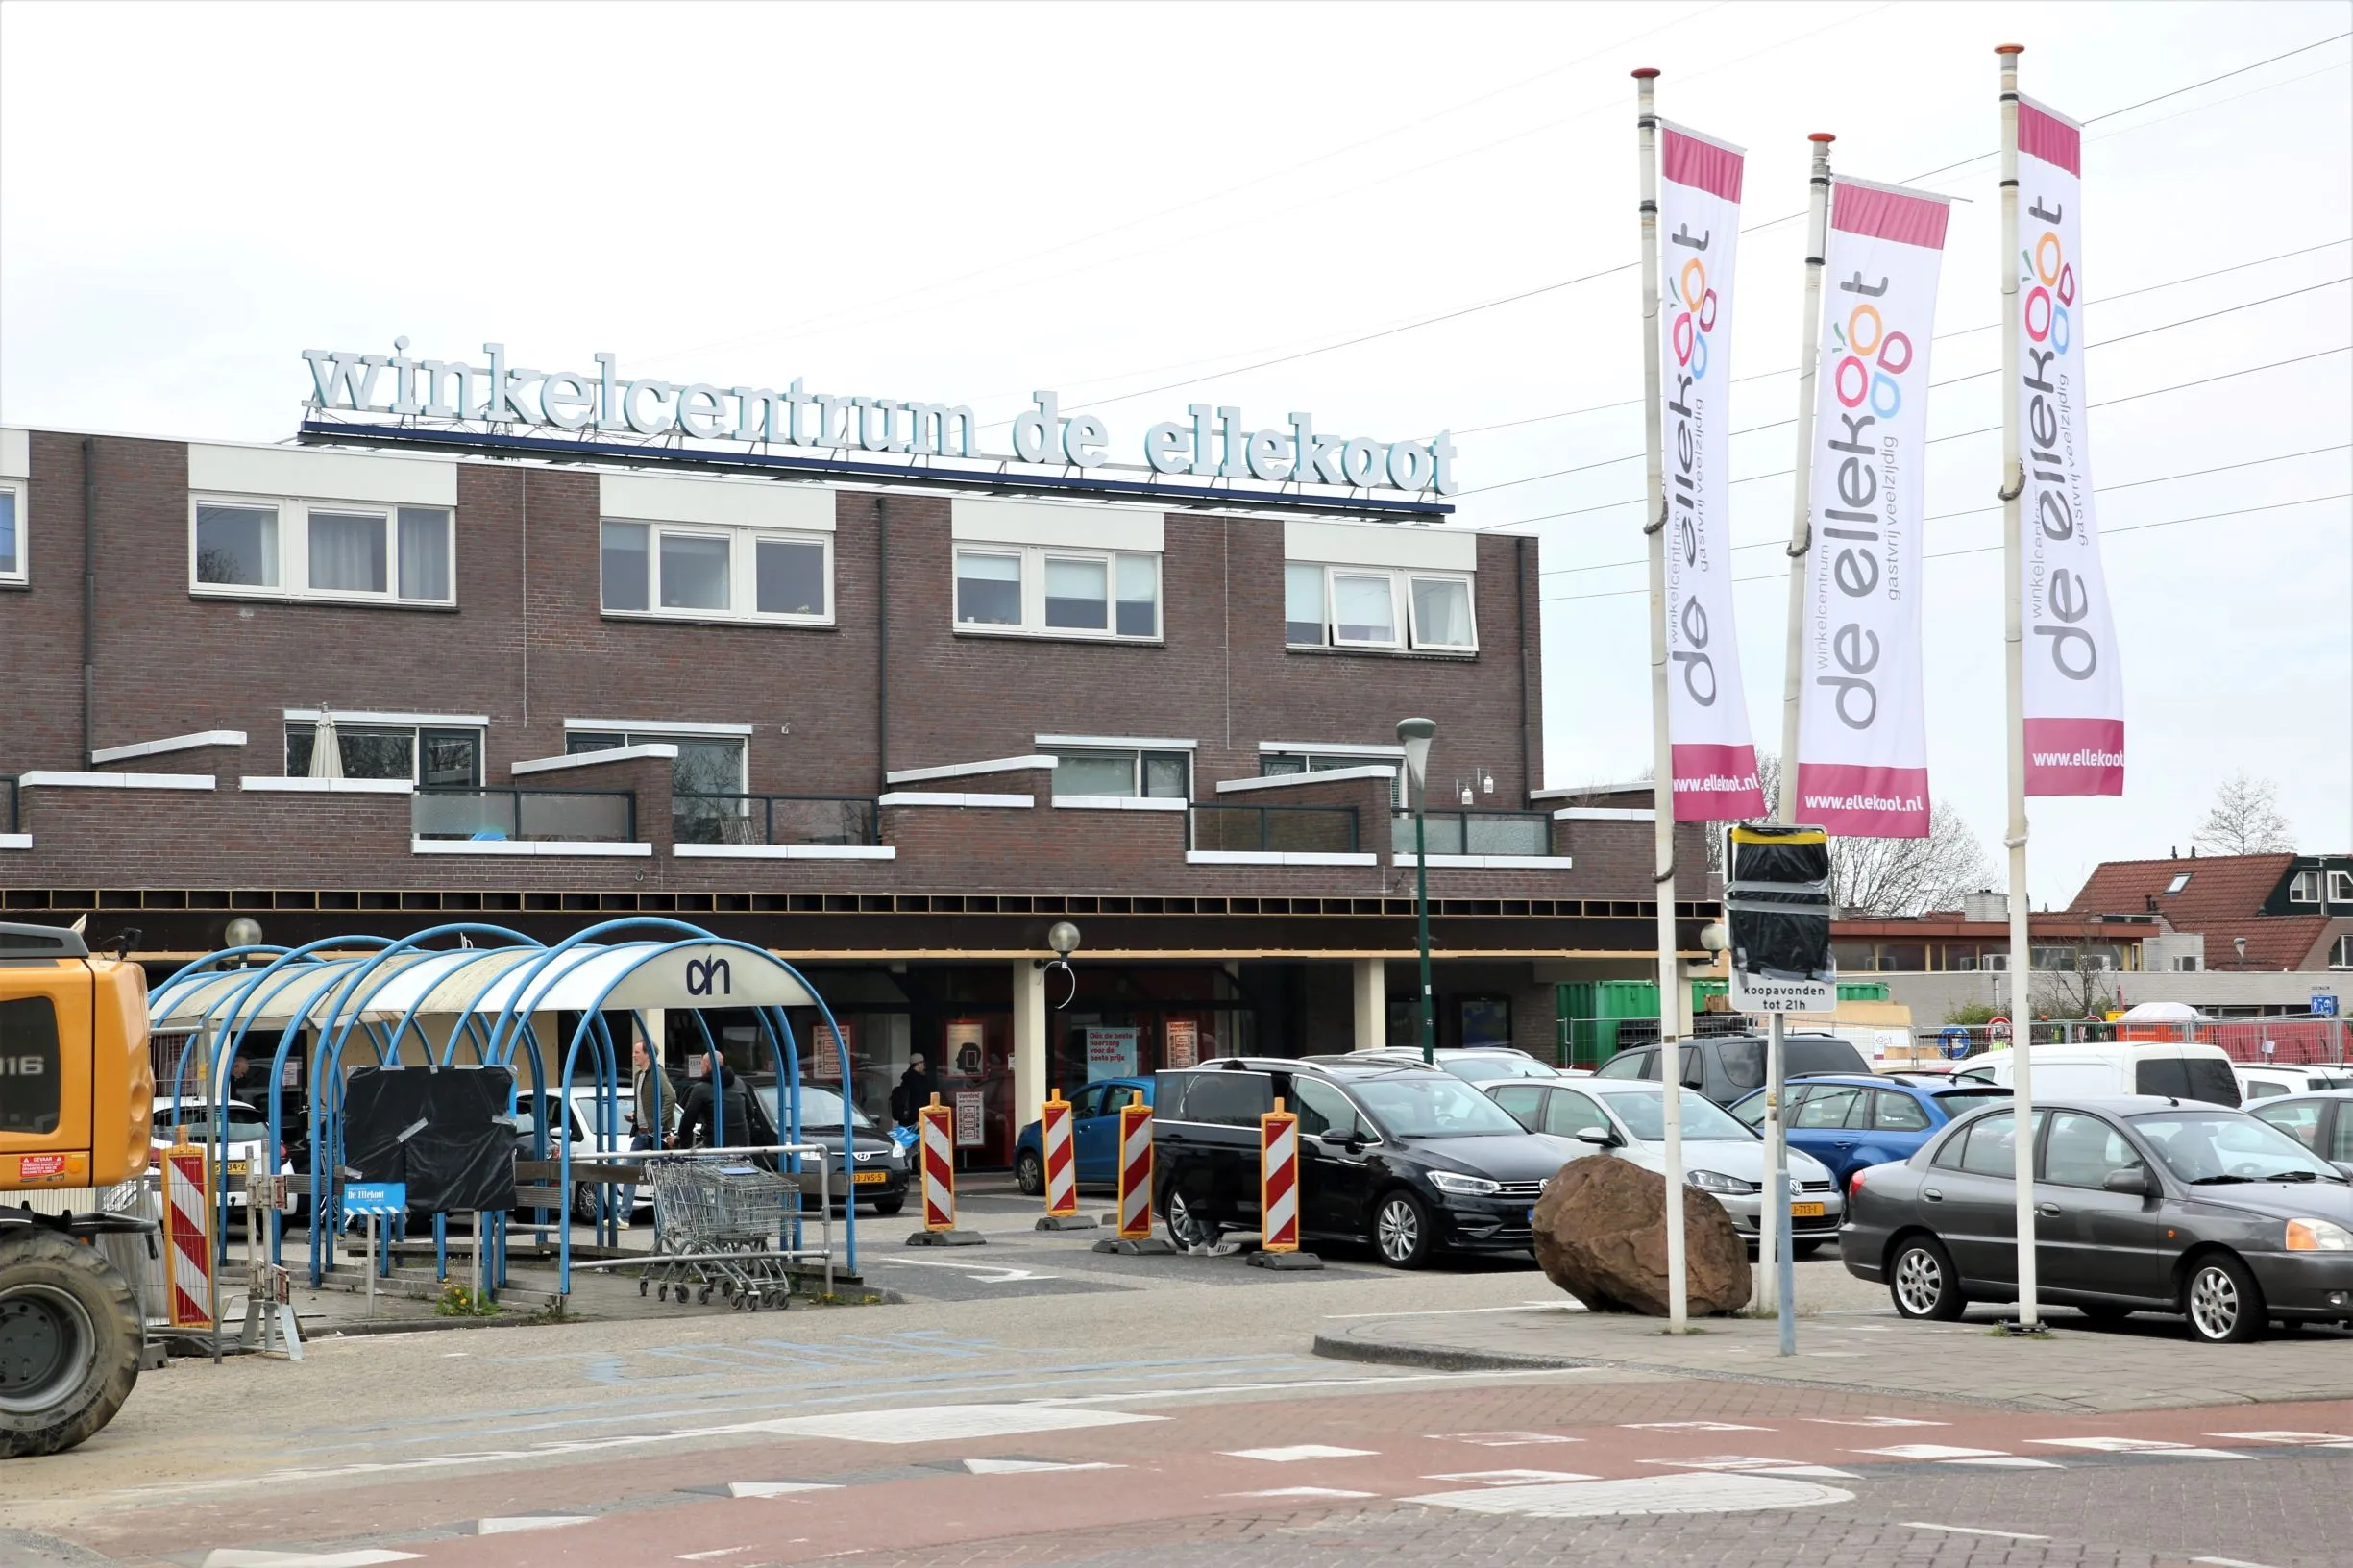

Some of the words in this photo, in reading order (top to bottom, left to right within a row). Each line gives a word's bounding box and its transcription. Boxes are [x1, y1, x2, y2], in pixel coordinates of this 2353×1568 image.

[301, 335, 982, 457] winkelcentrum
[1013, 391, 1109, 468] de
[1144, 404, 1458, 496] ellekoot
[1693, 398, 1705, 494] veelzijdig
[2057, 373, 2076, 468] veelzijdig
[1880, 436, 1899, 528] veelzijdig
[2072, 474, 2089, 546] gastvrij
[1669, 510, 1681, 643] winkelcentrum
[1697, 499, 1709, 572] gastvrij
[1883, 530, 1902, 600] gastvrij
[2029, 485, 2045, 618] winkelcent
[1672, 594, 1717, 707] de
[1815, 545, 1829, 670] winkelcentrum
[2033, 568, 2096, 681] de
[1816, 623, 1880, 730] de
[1805, 794, 1924, 812] www.ellekoot.nl
[1744, 986, 1826, 997] koopavonden
[1763, 999, 1780, 1010] tot
[1785, 999, 1806, 1010] 21h
